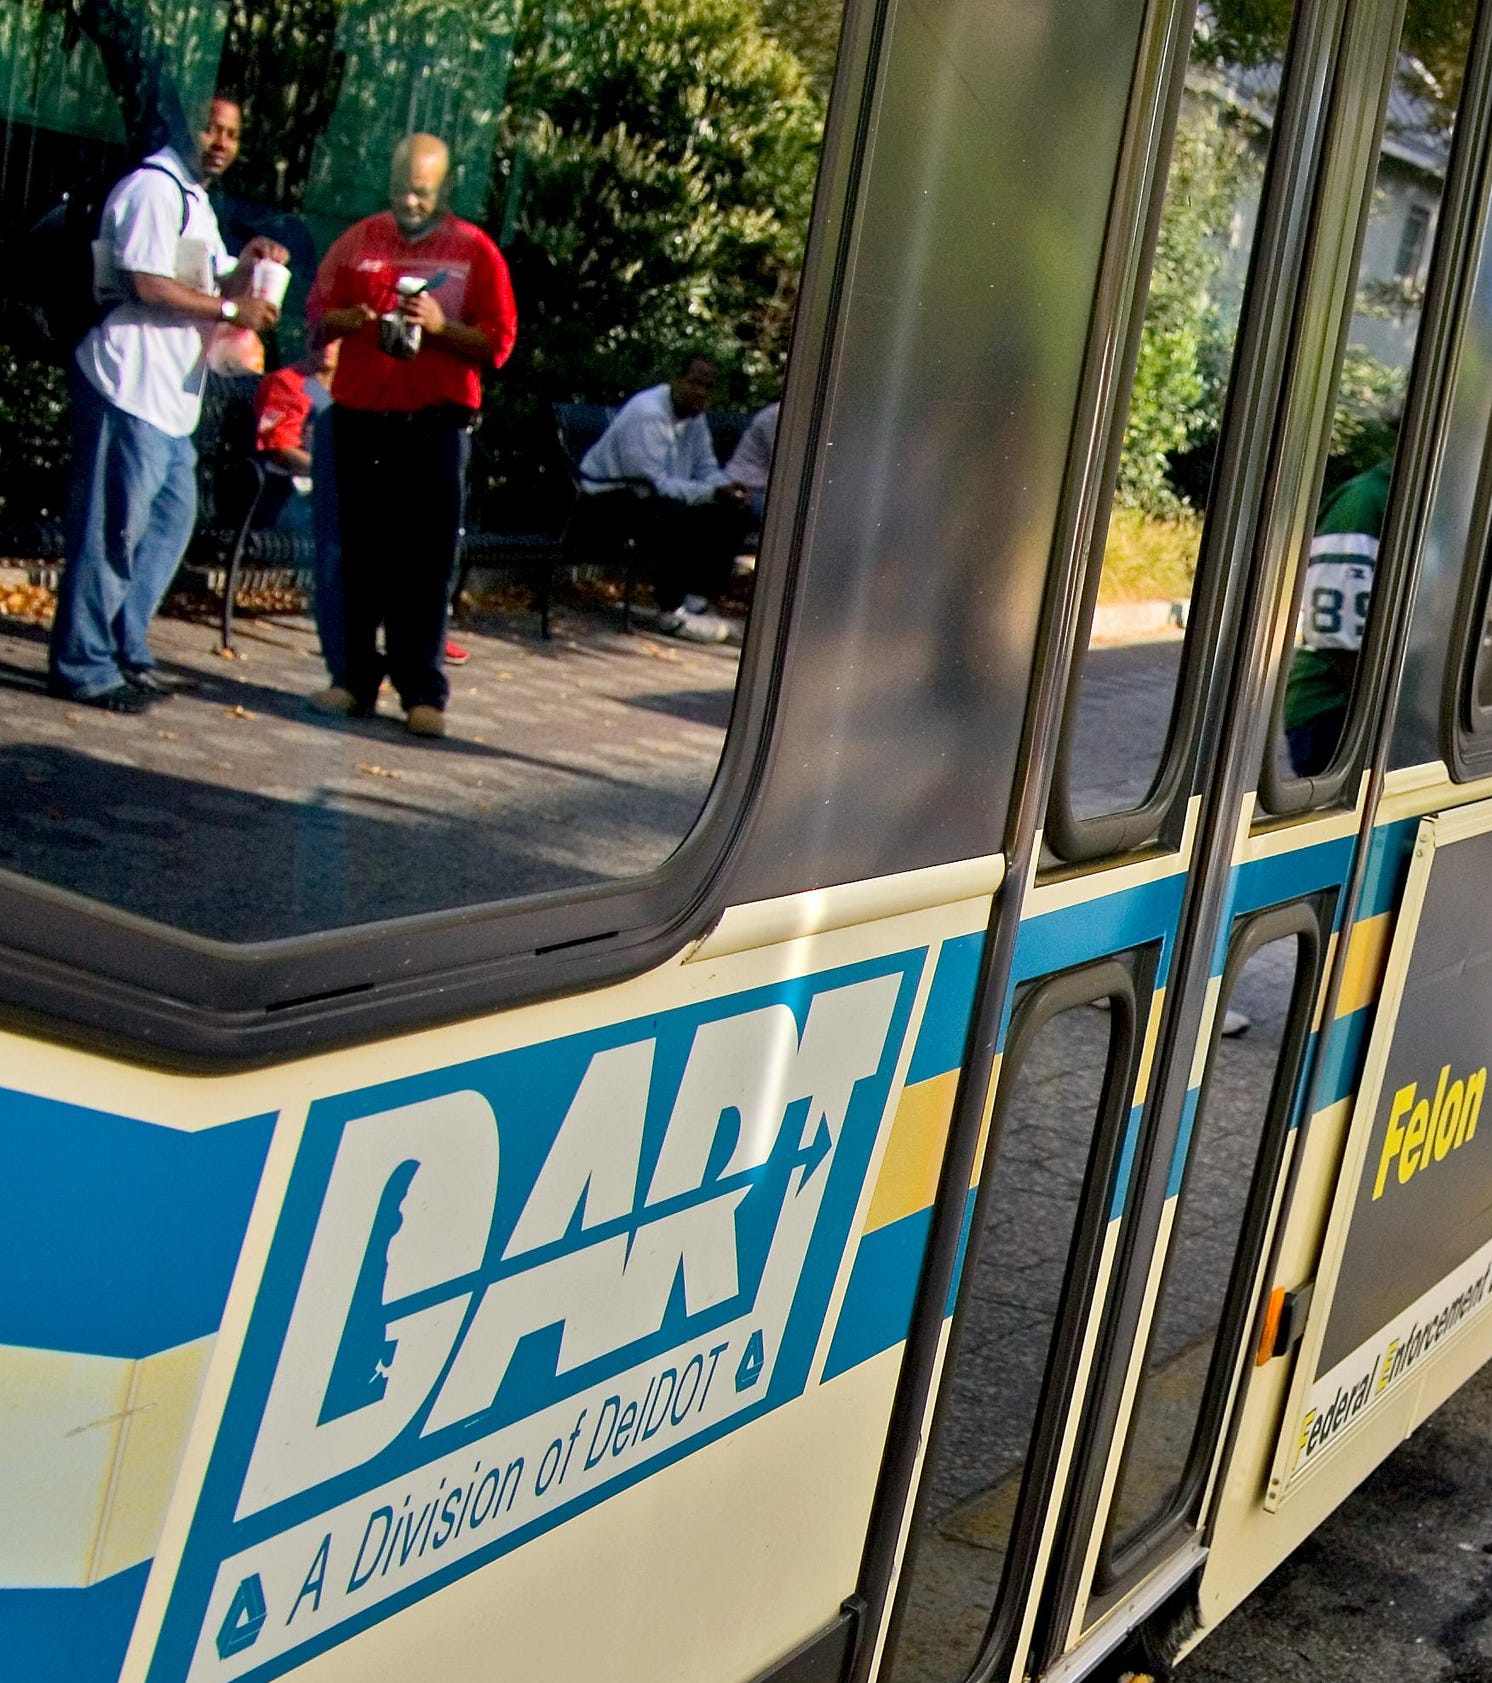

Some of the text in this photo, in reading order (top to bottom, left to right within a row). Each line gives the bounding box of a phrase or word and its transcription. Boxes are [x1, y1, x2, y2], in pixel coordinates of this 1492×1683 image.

[233, 970, 905, 1524] DART
[1372, 1064, 1487, 1201] Felon
[286, 1341, 730, 1627] A Division of DelDOT
[1292, 1354, 1381, 1469] Federal
[1376, 1261, 1492, 1396] Enforcement
